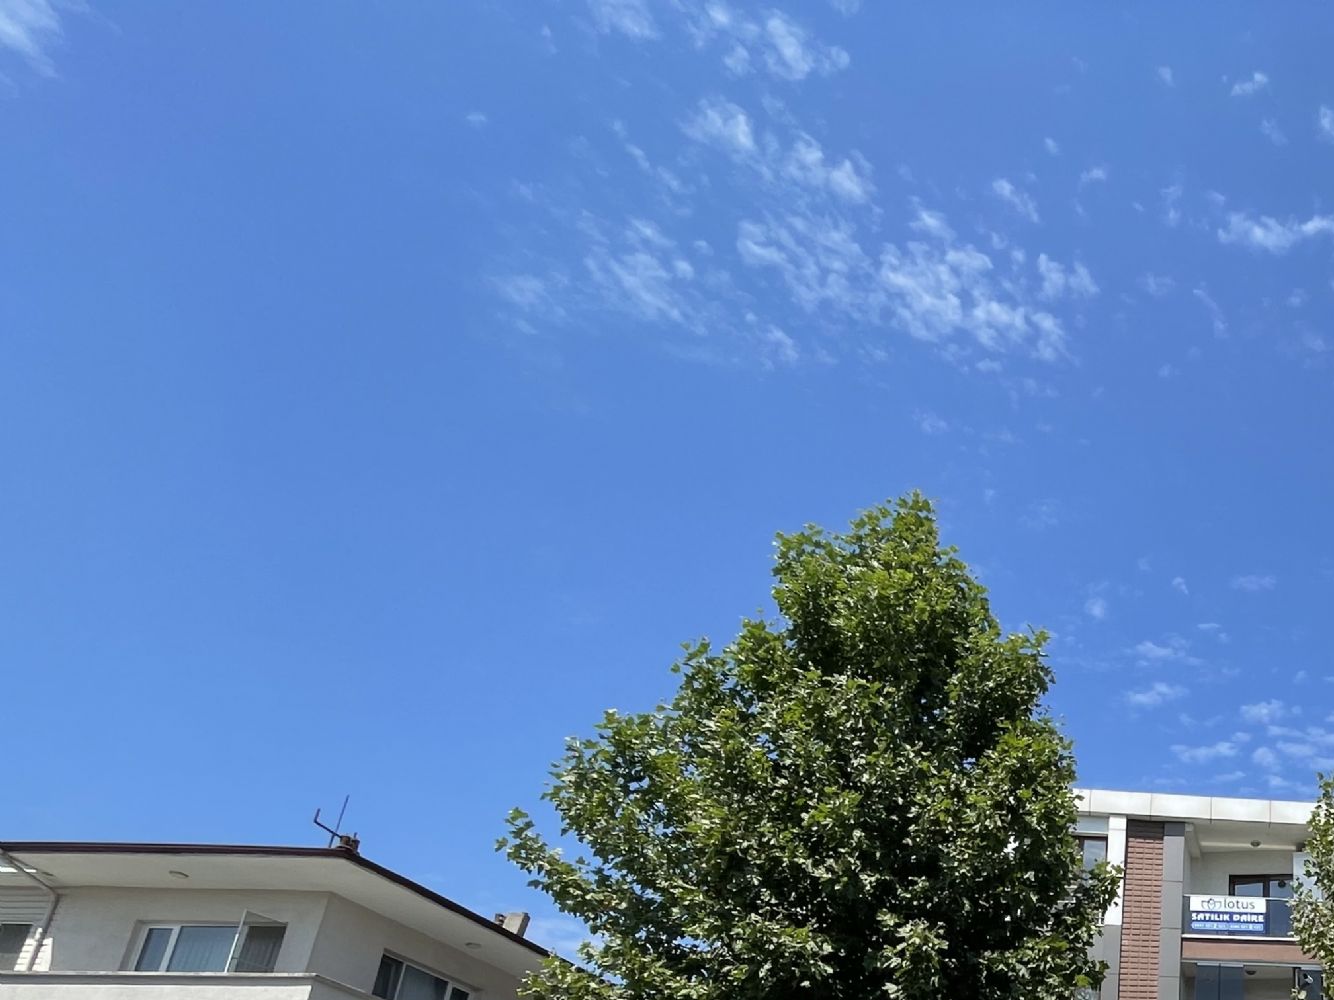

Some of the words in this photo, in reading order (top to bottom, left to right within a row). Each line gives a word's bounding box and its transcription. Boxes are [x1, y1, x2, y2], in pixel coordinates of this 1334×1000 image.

[1224, 898, 1255, 910] lotus
[1192, 913, 1230, 921] SATILIK
[1233, 912, 1264, 922] DAİRE
